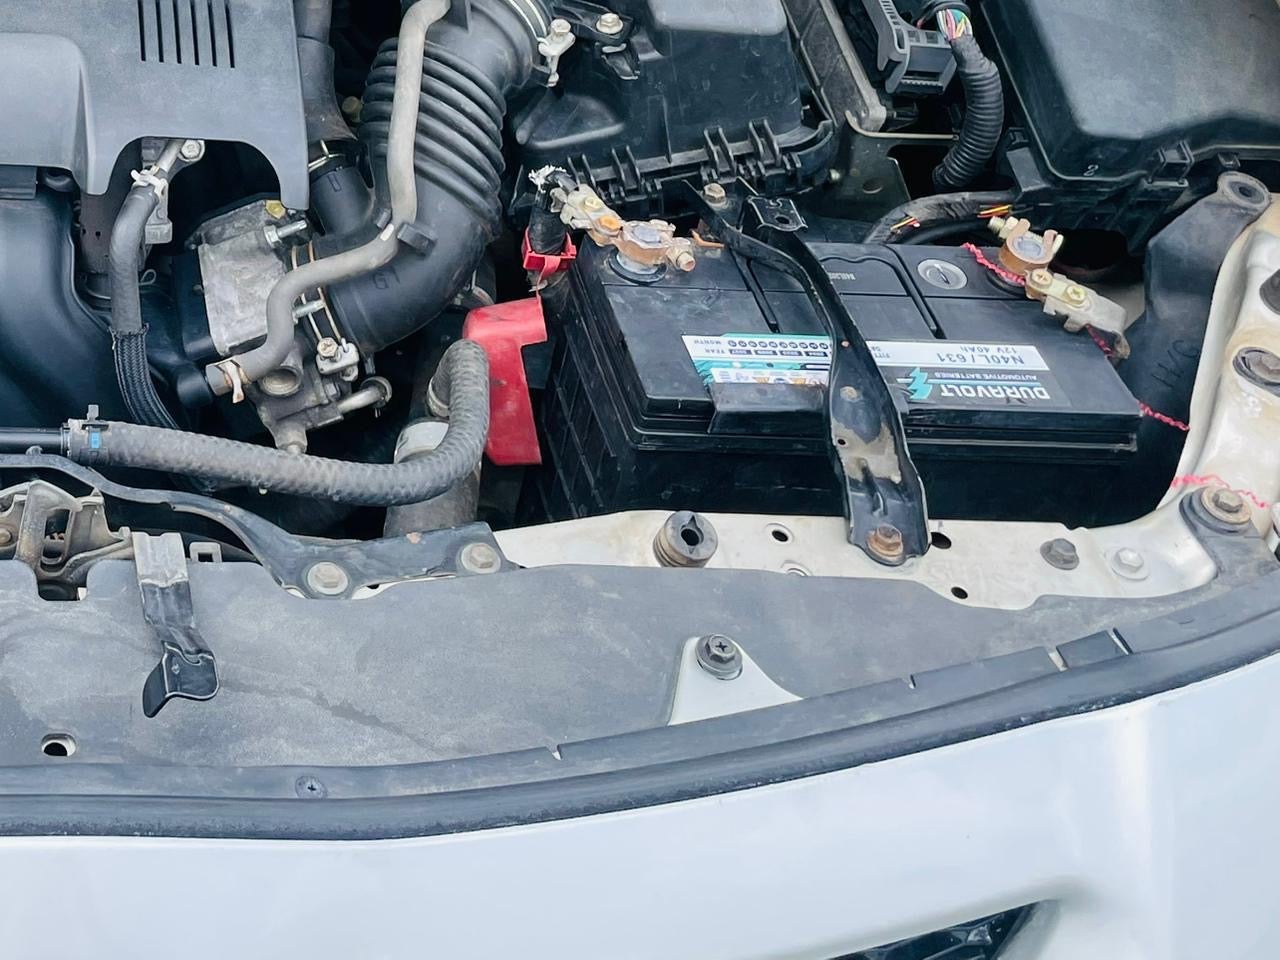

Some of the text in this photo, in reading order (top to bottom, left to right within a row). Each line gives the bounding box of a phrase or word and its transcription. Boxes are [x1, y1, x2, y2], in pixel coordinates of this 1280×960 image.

[960, 345, 1017, 354] 12V 40Ah
[934, 372, 1037, 381] AUTOMOTIVE BATTERIES
[939, 384, 1050, 400] DURAVOLT
